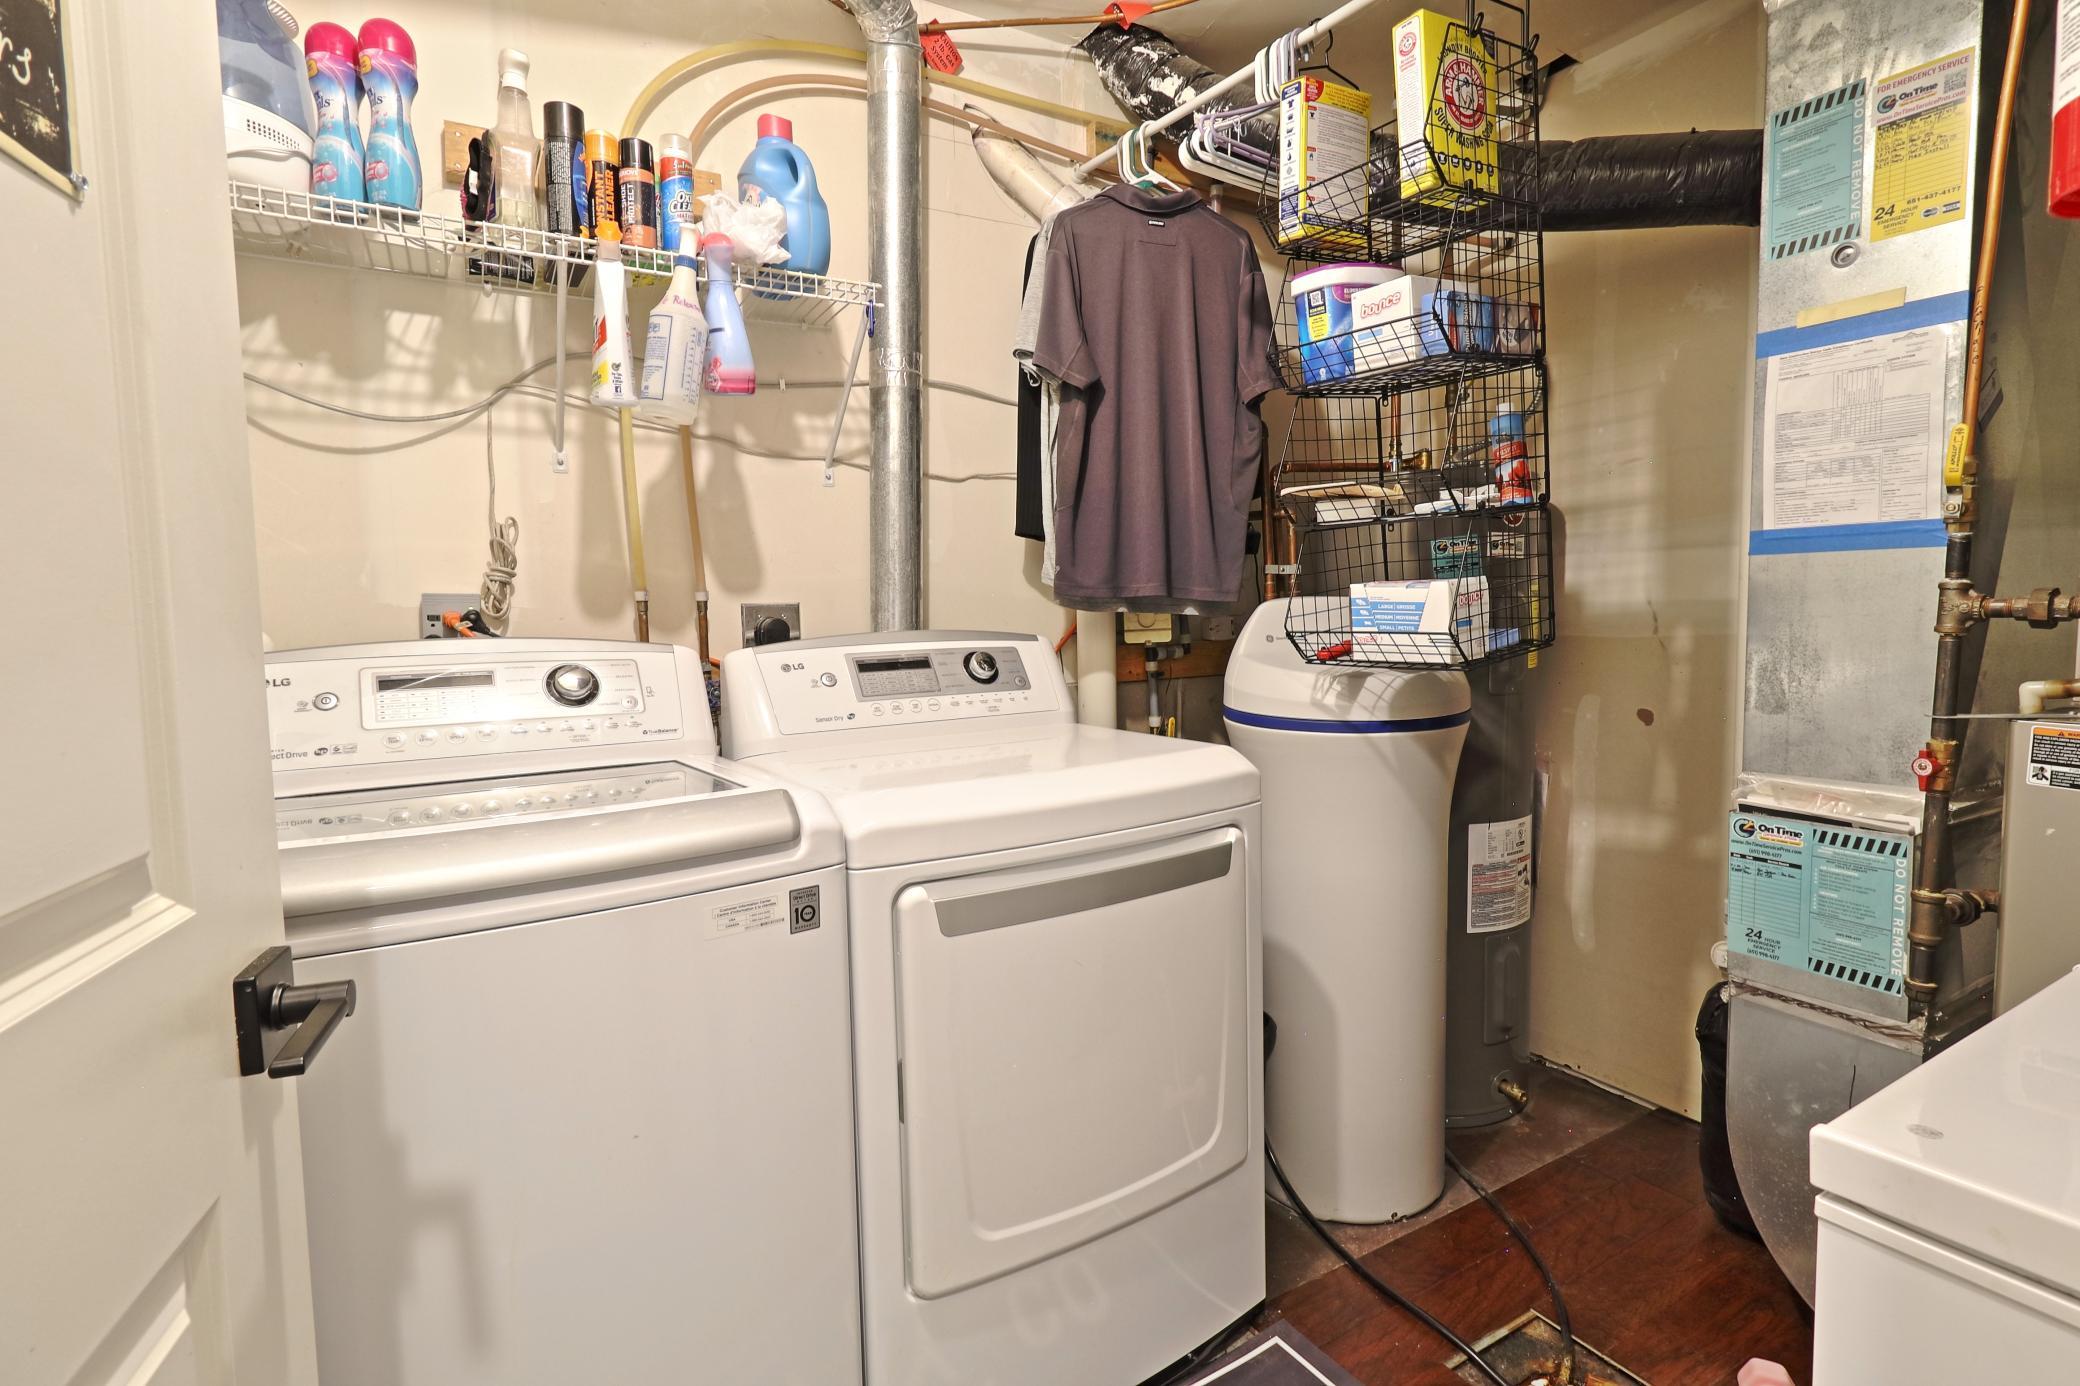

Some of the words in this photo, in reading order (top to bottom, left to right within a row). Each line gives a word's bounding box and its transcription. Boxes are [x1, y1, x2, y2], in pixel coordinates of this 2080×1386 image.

[1876, 84, 1892, 94] FOR
[1892, 67, 1937, 89] EMERGENCY
[1938, 55, 1970, 73] SERVICE
[1899, 90, 1913, 101] On
[1913, 83, 1938, 97] Time
[1854, 97, 1865, 119] DO
[1852, 123, 1864, 153] NOT
[594, 170, 605, 223] NSTANT
[1850, 159, 1863, 220] REMOVE
[627, 183, 636, 224] PROTECT
[1874, 203, 1896, 221] 24
[1360, 291, 1402, 320] bounce
[793, 662, 805, 671] LG
[272, 678, 291, 688] LG
[285, 750, 308, 760] Drive
[1758, 824, 1774, 834] On
[1774, 825, 1803, 839] Time
[1895, 858, 1907, 879] DO
[1893, 884, 1906, 914] NOT
[794, 904, 816, 925] 10
[1745, 927, 1763, 940] 24
[1890, 917, 1904, 977] REMOVE
